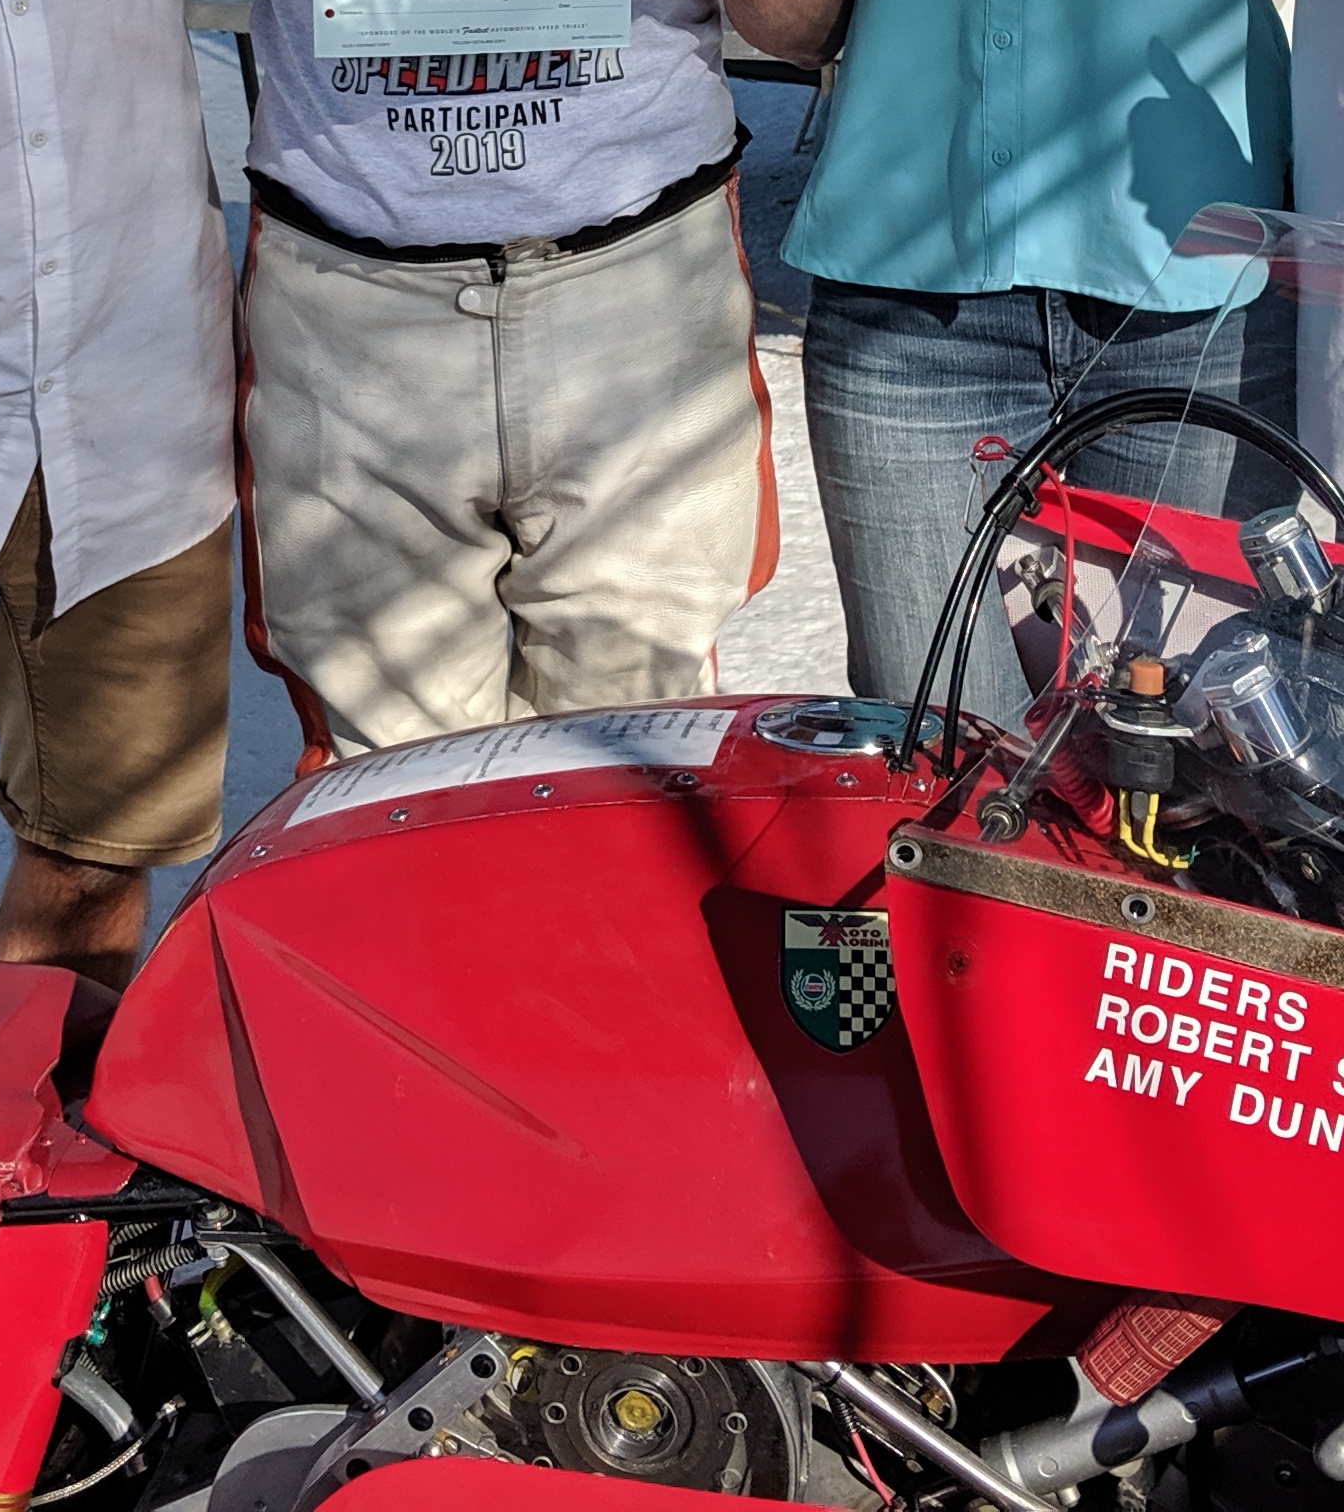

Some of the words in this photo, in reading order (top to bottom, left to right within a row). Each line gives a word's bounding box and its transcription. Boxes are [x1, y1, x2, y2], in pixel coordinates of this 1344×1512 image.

[386, 97, 564, 133] PARTICIPANT
[430, 128, 526, 177] 2019
[1104, 942, 1309, 1033] RIDERS
[1095, 993, 1313, 1082] ROBERT
[1084, 1048, 1203, 1107] AMY
